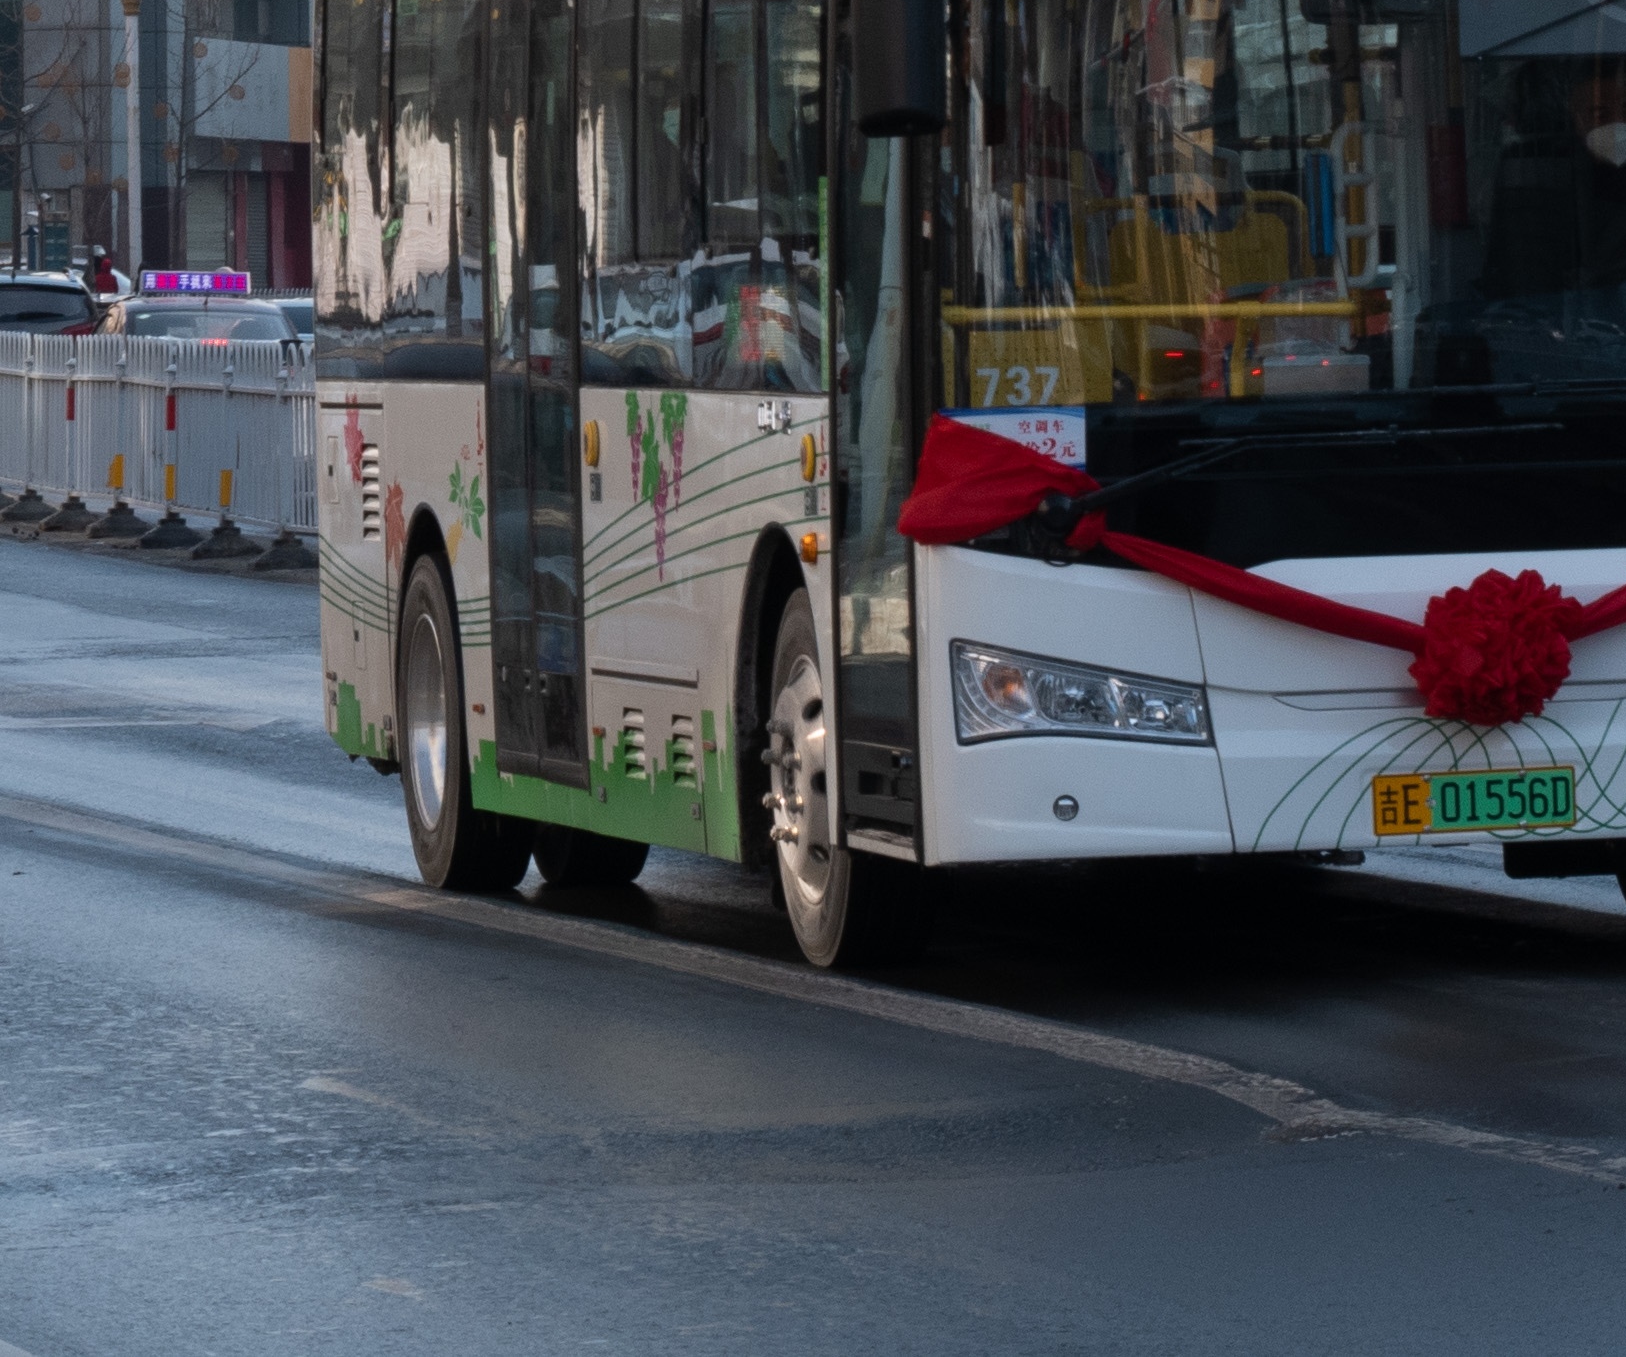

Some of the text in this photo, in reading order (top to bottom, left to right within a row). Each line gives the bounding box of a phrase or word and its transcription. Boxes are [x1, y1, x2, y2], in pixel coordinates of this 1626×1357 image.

[975, 365, 1060, 407] 737
[1018, 419, 1065, 434] 空调车
